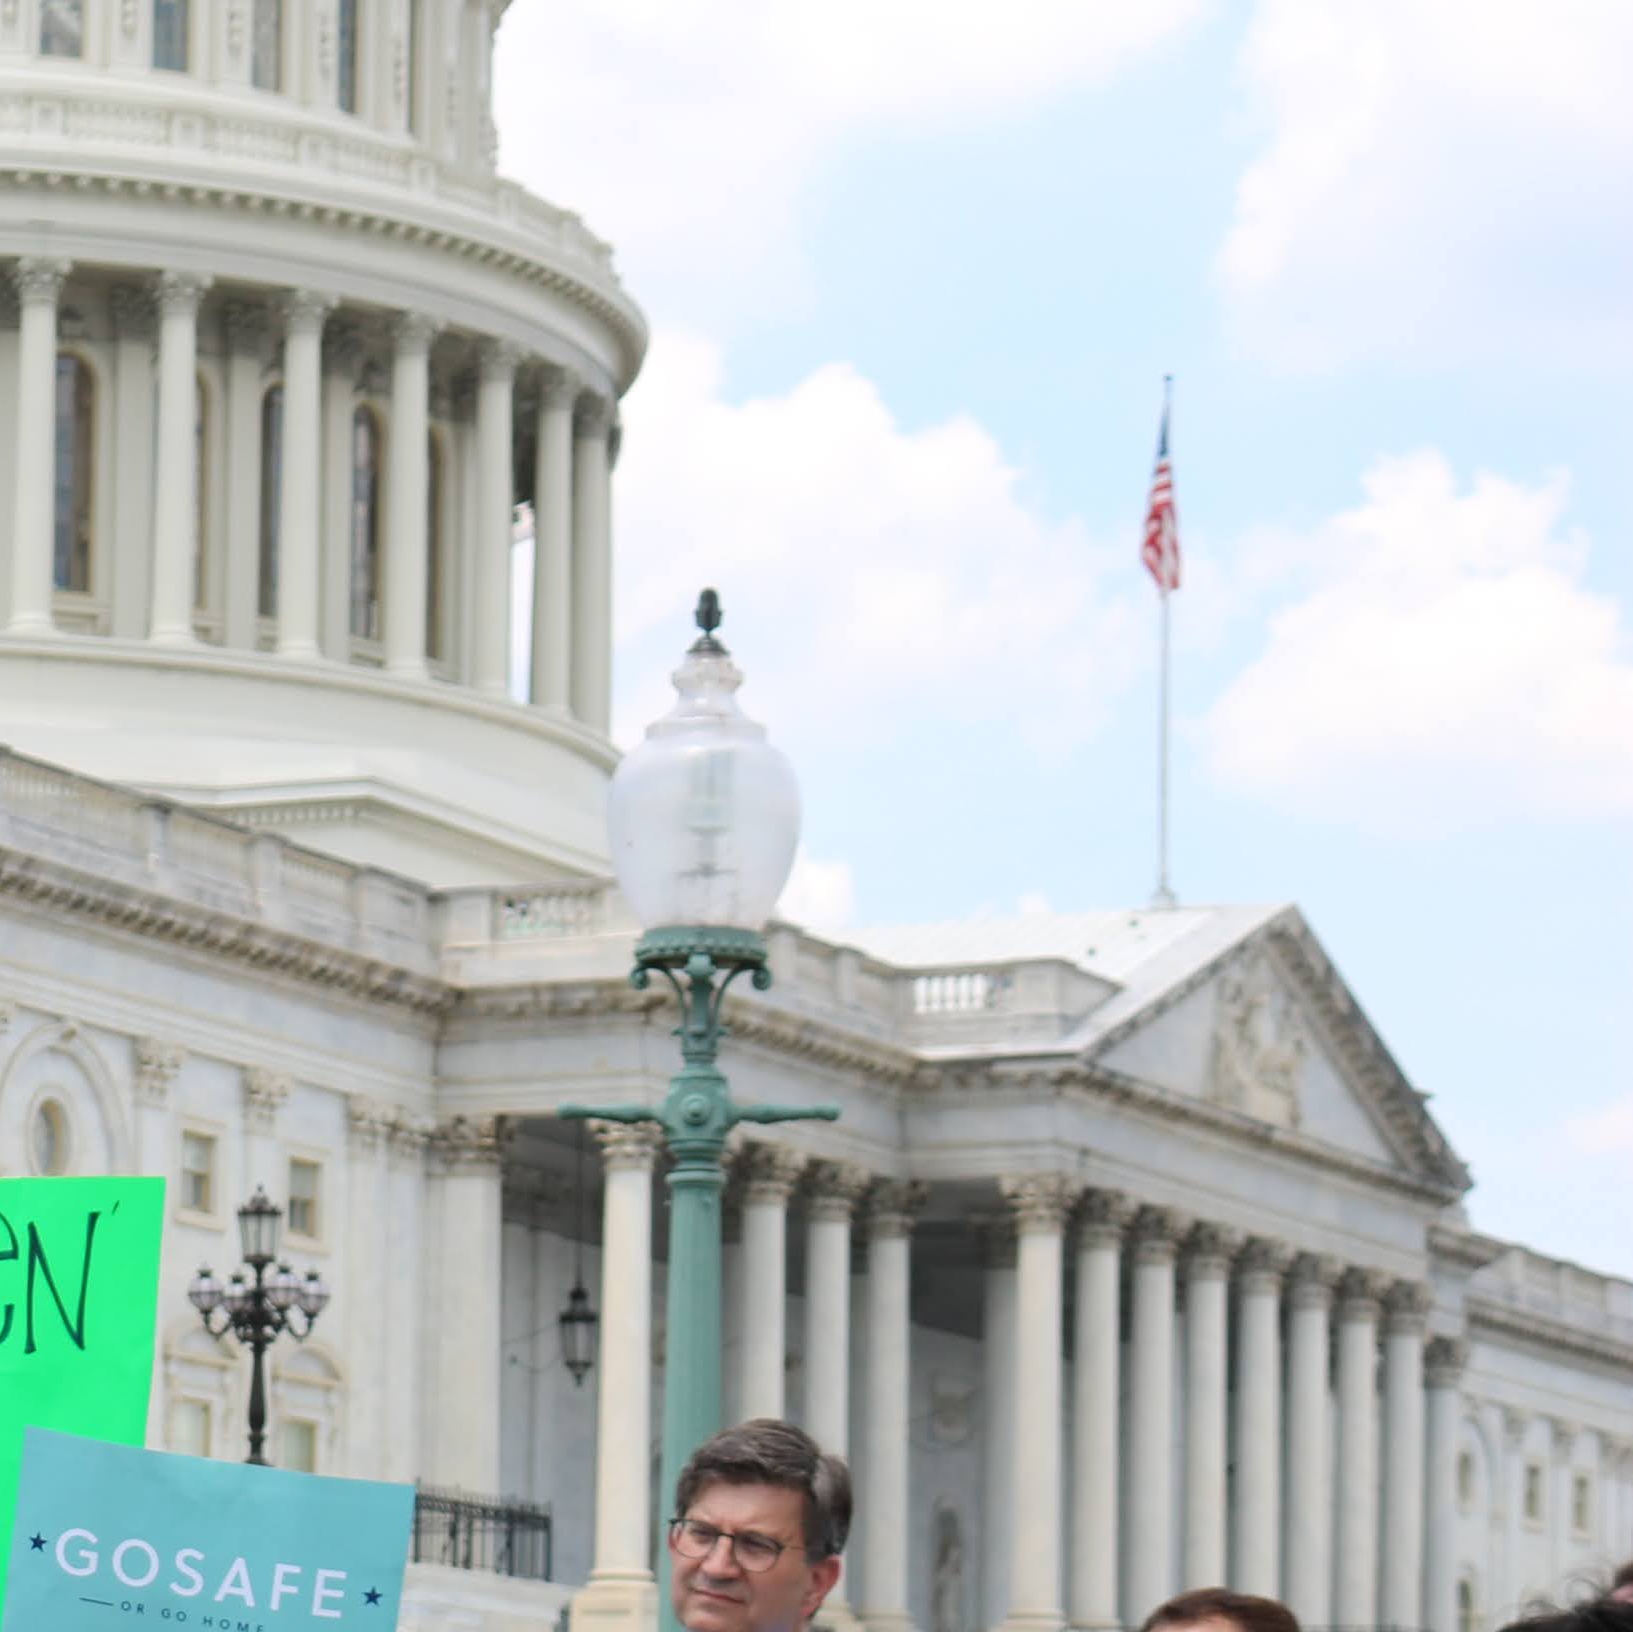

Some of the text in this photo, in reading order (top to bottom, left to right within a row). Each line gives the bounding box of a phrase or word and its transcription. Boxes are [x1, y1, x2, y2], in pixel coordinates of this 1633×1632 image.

[55, 1527, 347, 1619] GOSAFE
[120, 1600, 145, 1614] OR
[161, 1607, 187, 1622] GO
